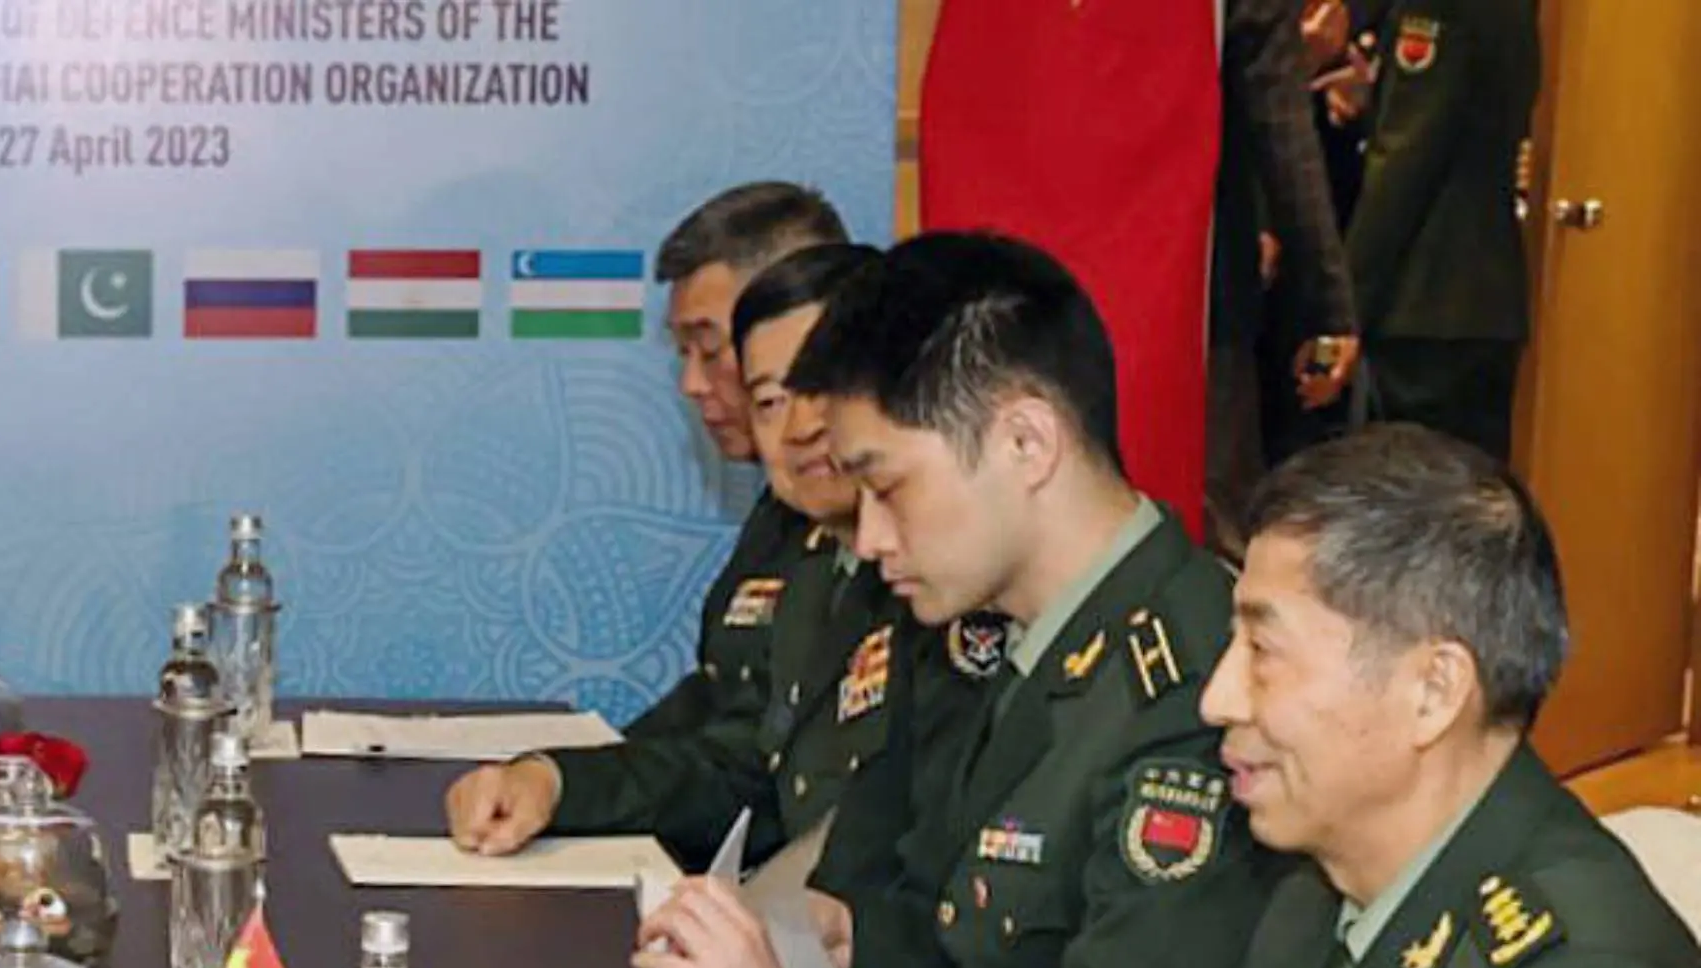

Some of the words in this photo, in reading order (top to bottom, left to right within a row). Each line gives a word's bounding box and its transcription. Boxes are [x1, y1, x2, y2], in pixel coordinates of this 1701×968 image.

[56, 0, 216, 39] DEFENCE
[228, 0, 426, 41] MINISTERS
[437, 0, 480, 41] OF
[494, 0, 559, 41] THE
[60, 61, 312, 104] COOPERATION
[325, 61, 590, 105] ORGANIZATION
[49, 124, 134, 176] April
[145, 124, 231, 168] 2023
